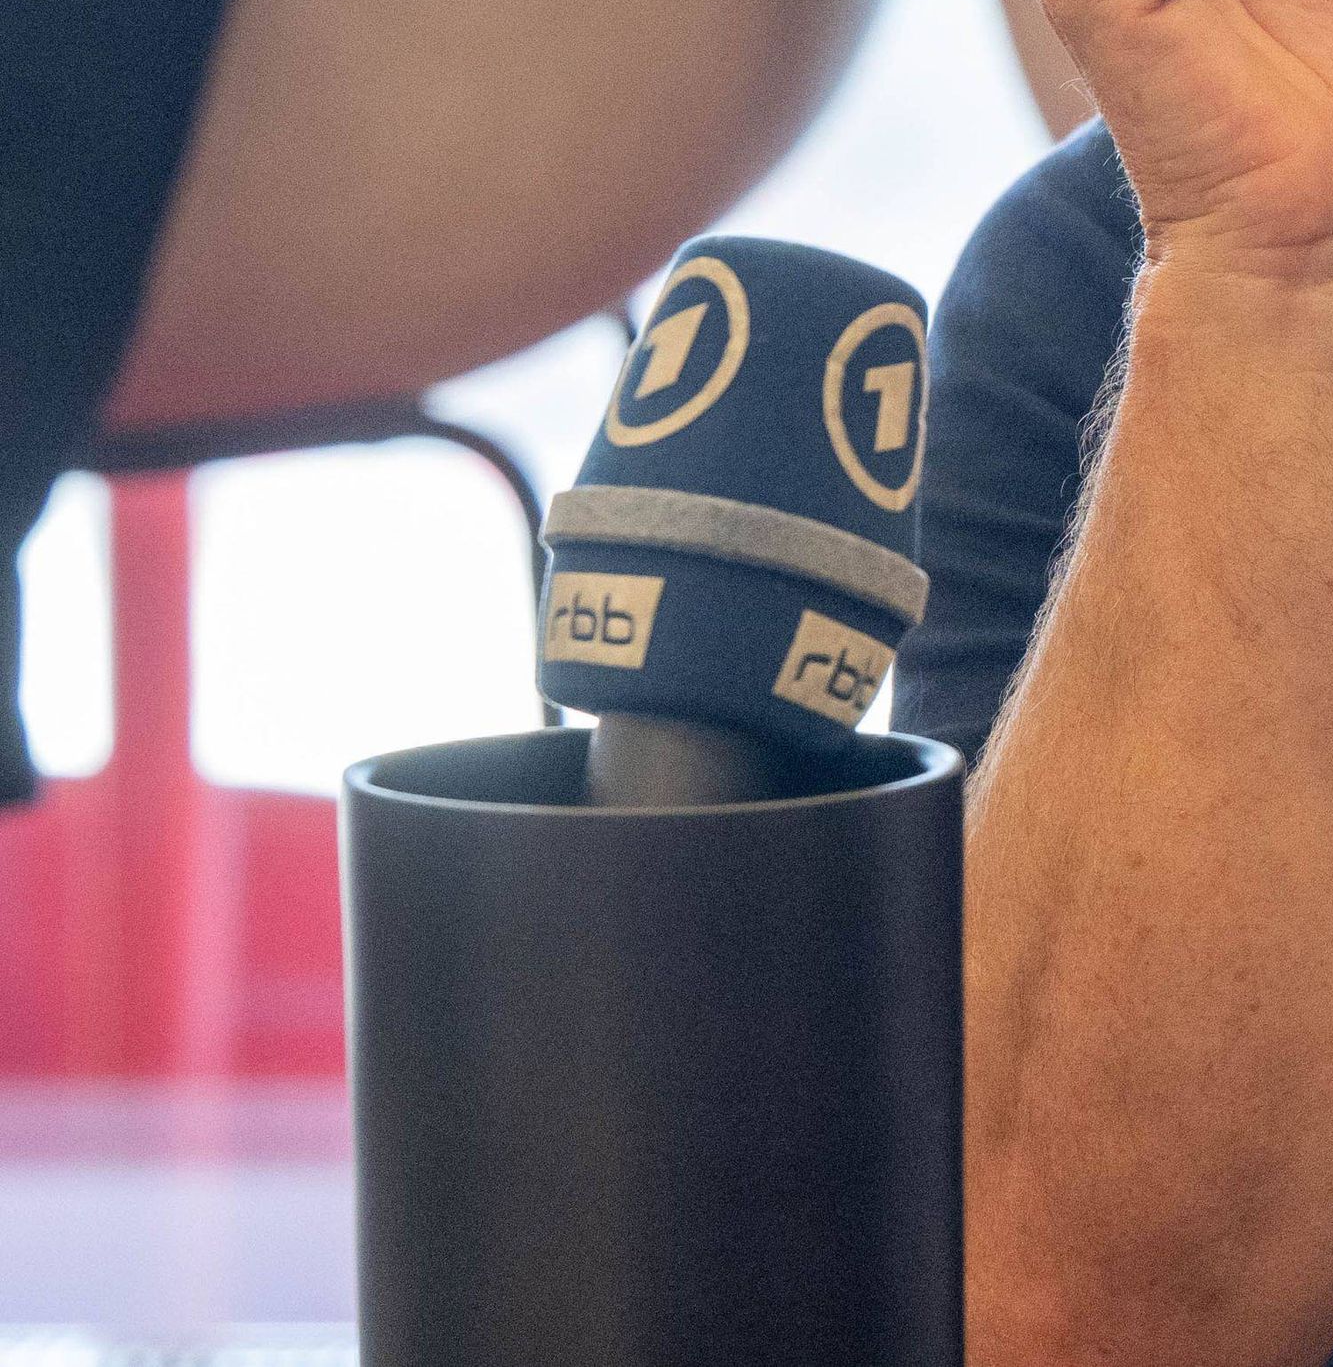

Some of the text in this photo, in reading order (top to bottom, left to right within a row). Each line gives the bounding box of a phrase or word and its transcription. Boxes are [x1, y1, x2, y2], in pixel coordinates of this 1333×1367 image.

[634, 301, 711, 400] 1
[863, 361, 916, 454] 1
[551, 591, 635, 646] rbb
